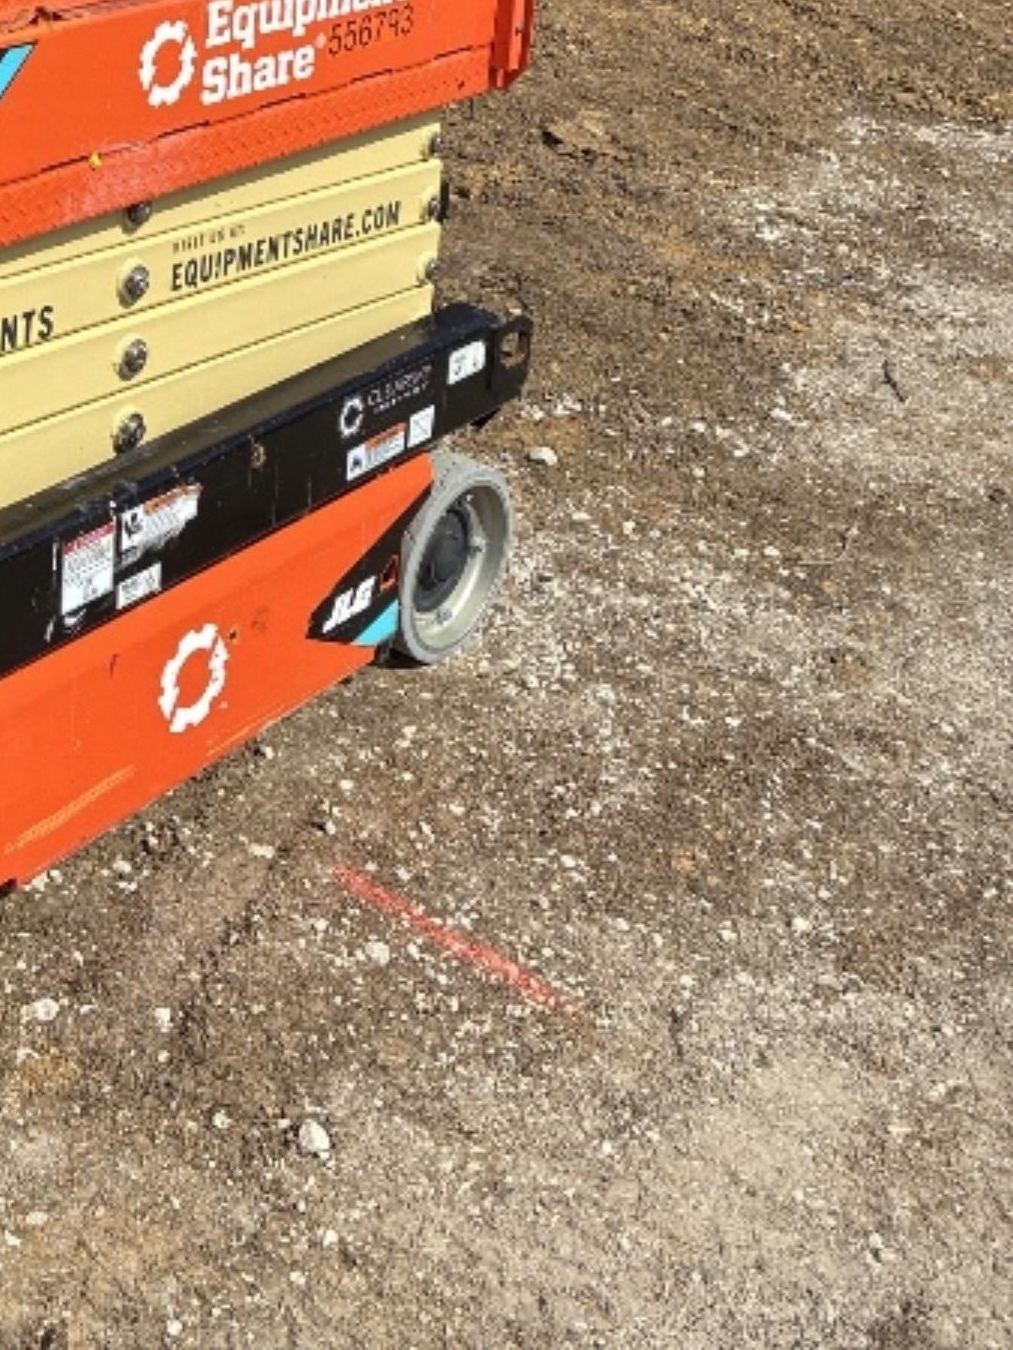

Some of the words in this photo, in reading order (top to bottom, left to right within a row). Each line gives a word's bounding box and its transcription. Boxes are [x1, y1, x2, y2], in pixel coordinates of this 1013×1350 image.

[328, 3, 415, 57] 556793
[200, 44, 316, 106] Share
[171, 201, 402, 292] EQUIPMENTSHARE.COM
[322, 574, 377, 634] JLG
